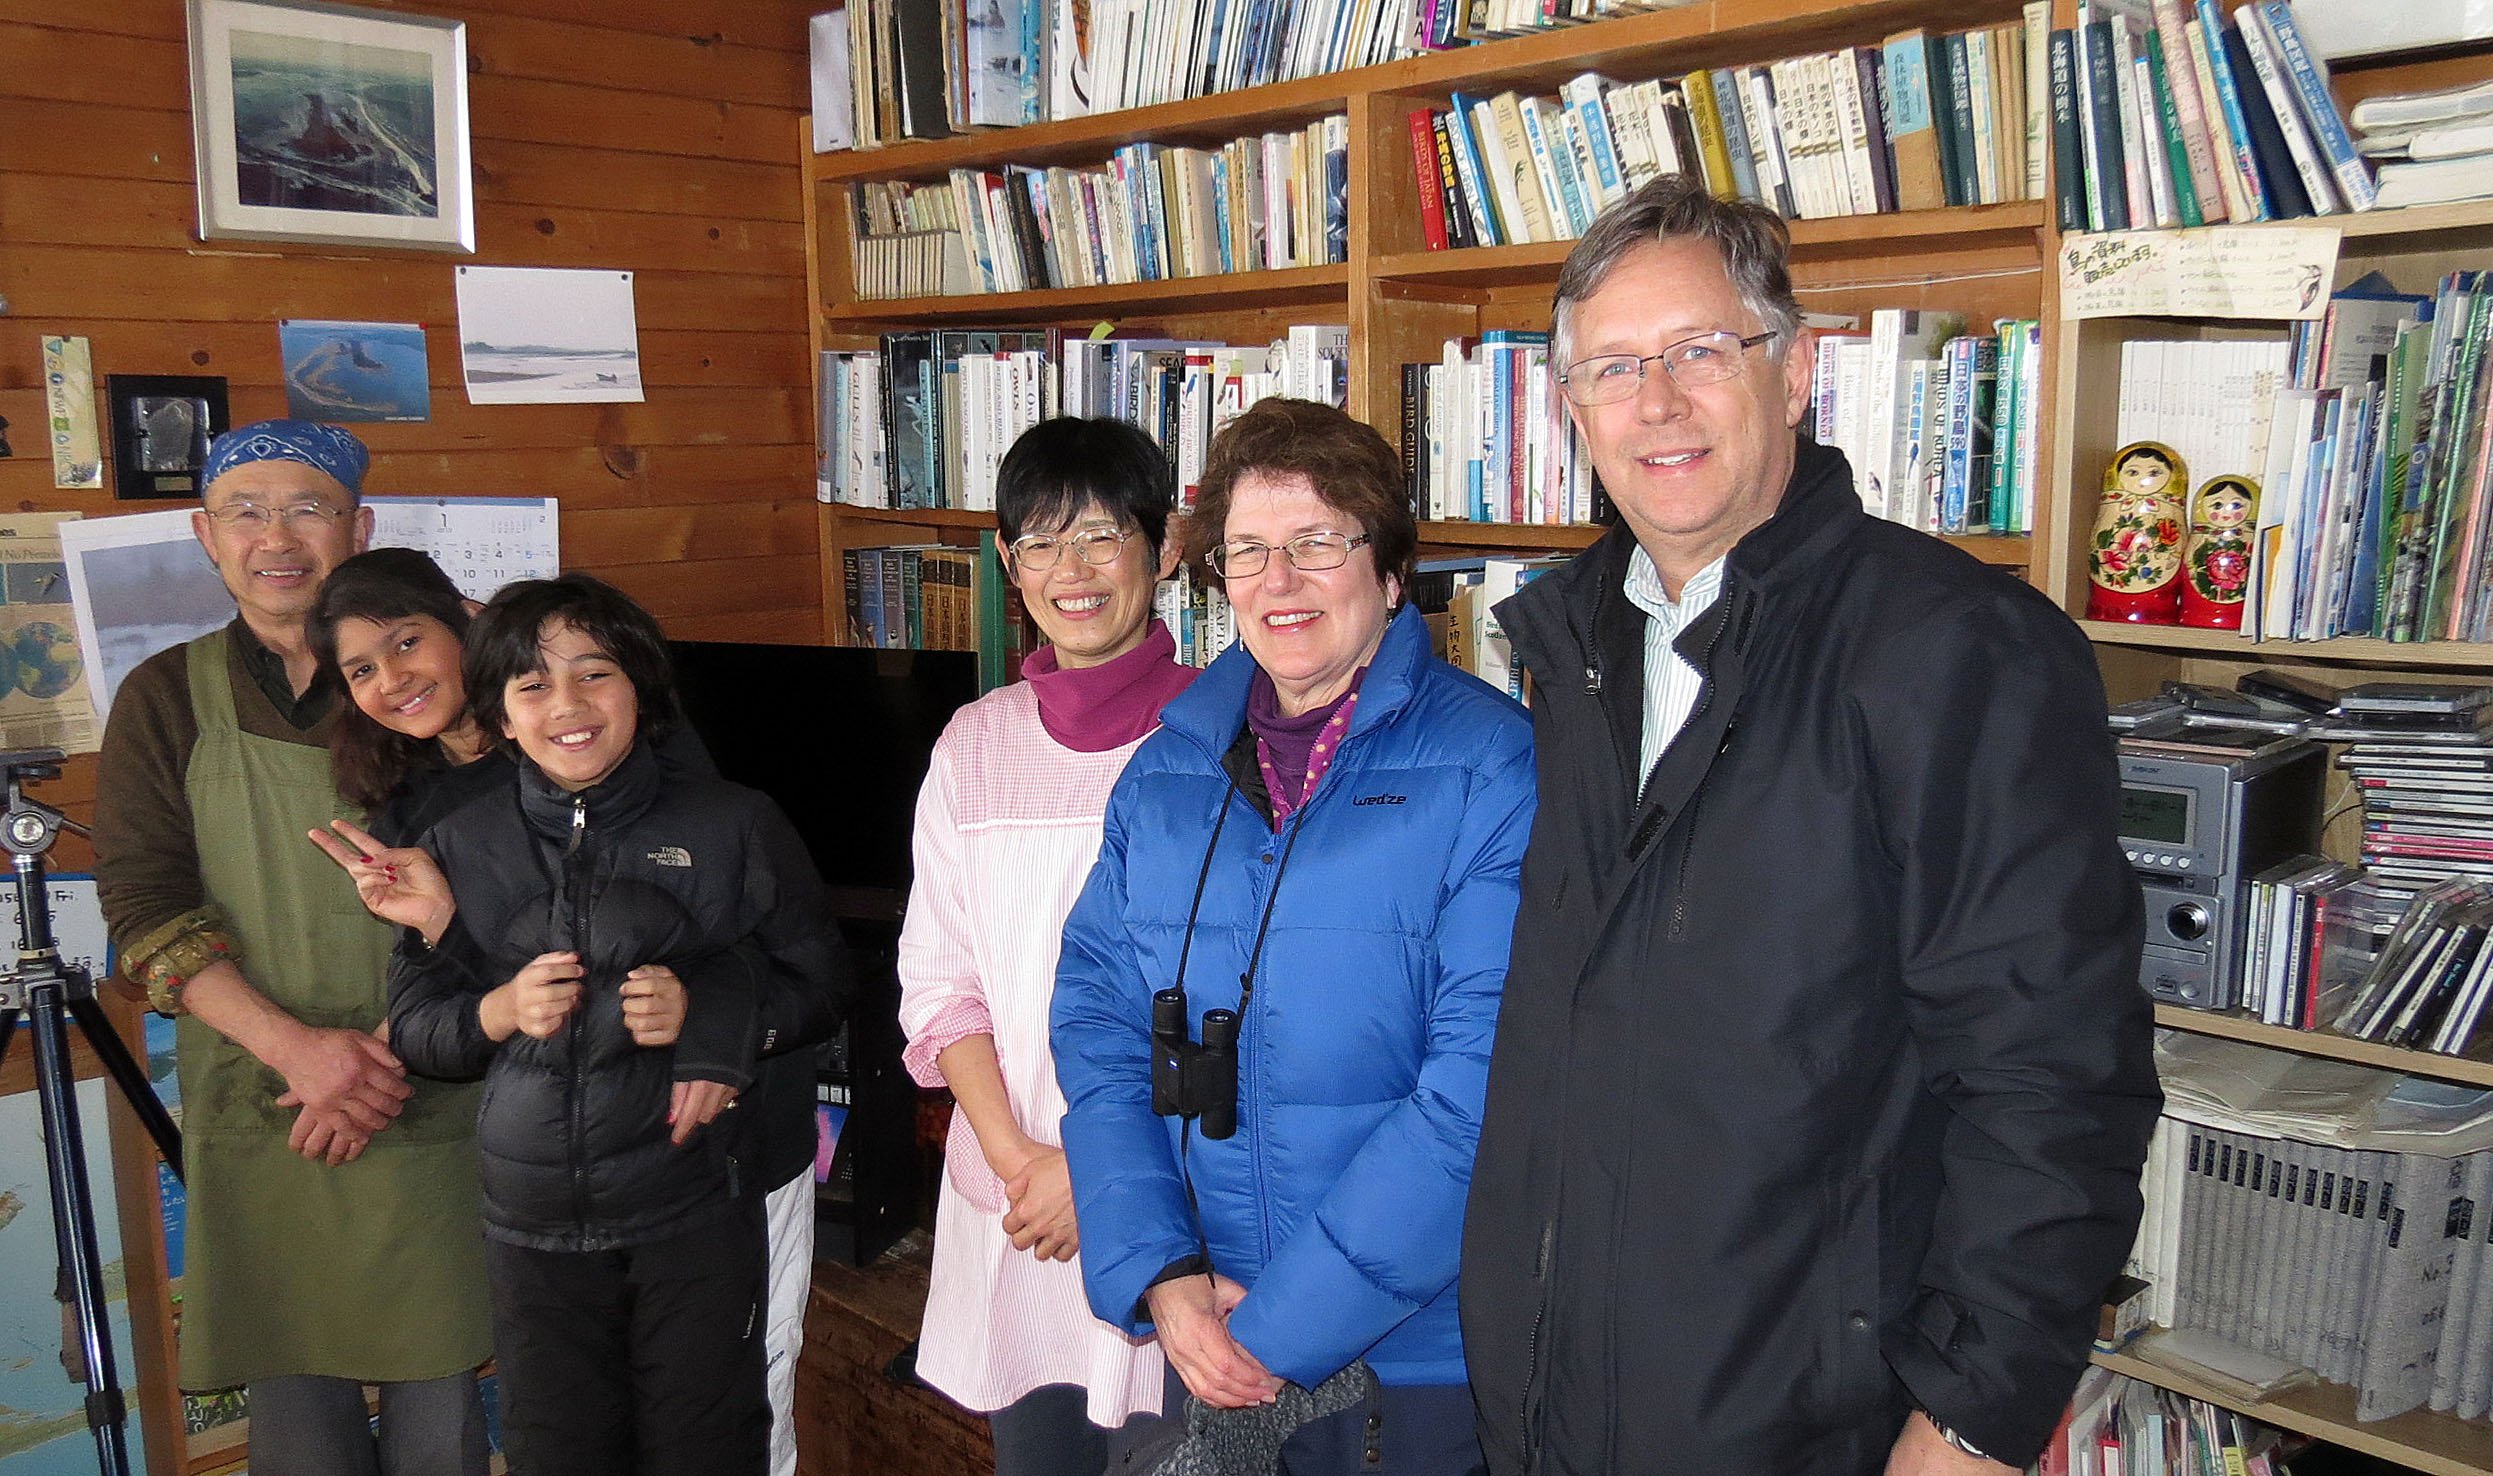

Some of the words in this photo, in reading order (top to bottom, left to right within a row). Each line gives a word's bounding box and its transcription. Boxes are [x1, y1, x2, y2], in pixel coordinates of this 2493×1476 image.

[1418, 131, 1428, 158] BIRDS
[1422, 179, 1434, 209] JAPAN
[1333, 334, 1348, 345] TH
[1823, 342, 1831, 375] BIRDS
[853, 371, 861, 423] GULLS
[1012, 367, 1020, 411] OWLS
[1937, 368, 1949, 410] BIRDS
[1952, 362, 1968, 436] 日本の野鳥
[1405, 396, 1415, 429] BIRD
[1820, 394, 1831, 438] BORNEO
[1405, 433, 1415, 474] GUIDE
[1933, 434, 1947, 478] KOREA
[1951, 436, 1966, 449] 590
[441, 513, 447, 527] 1
[465, 550, 473, 559] 3
[495, 550, 503, 559] 4
[525, 551, 532, 559] 5
[463, 569, 476, 578] 10
[494, 569, 505, 578] 11
[524, 569, 537, 577] 12
[1216, 601, 1225, 653] RAPTO
[1183, 643, 1192, 665] BIRD
[1509, 668, 1520, 699] BIRD
[647, 852, 679, 860] NORTH
